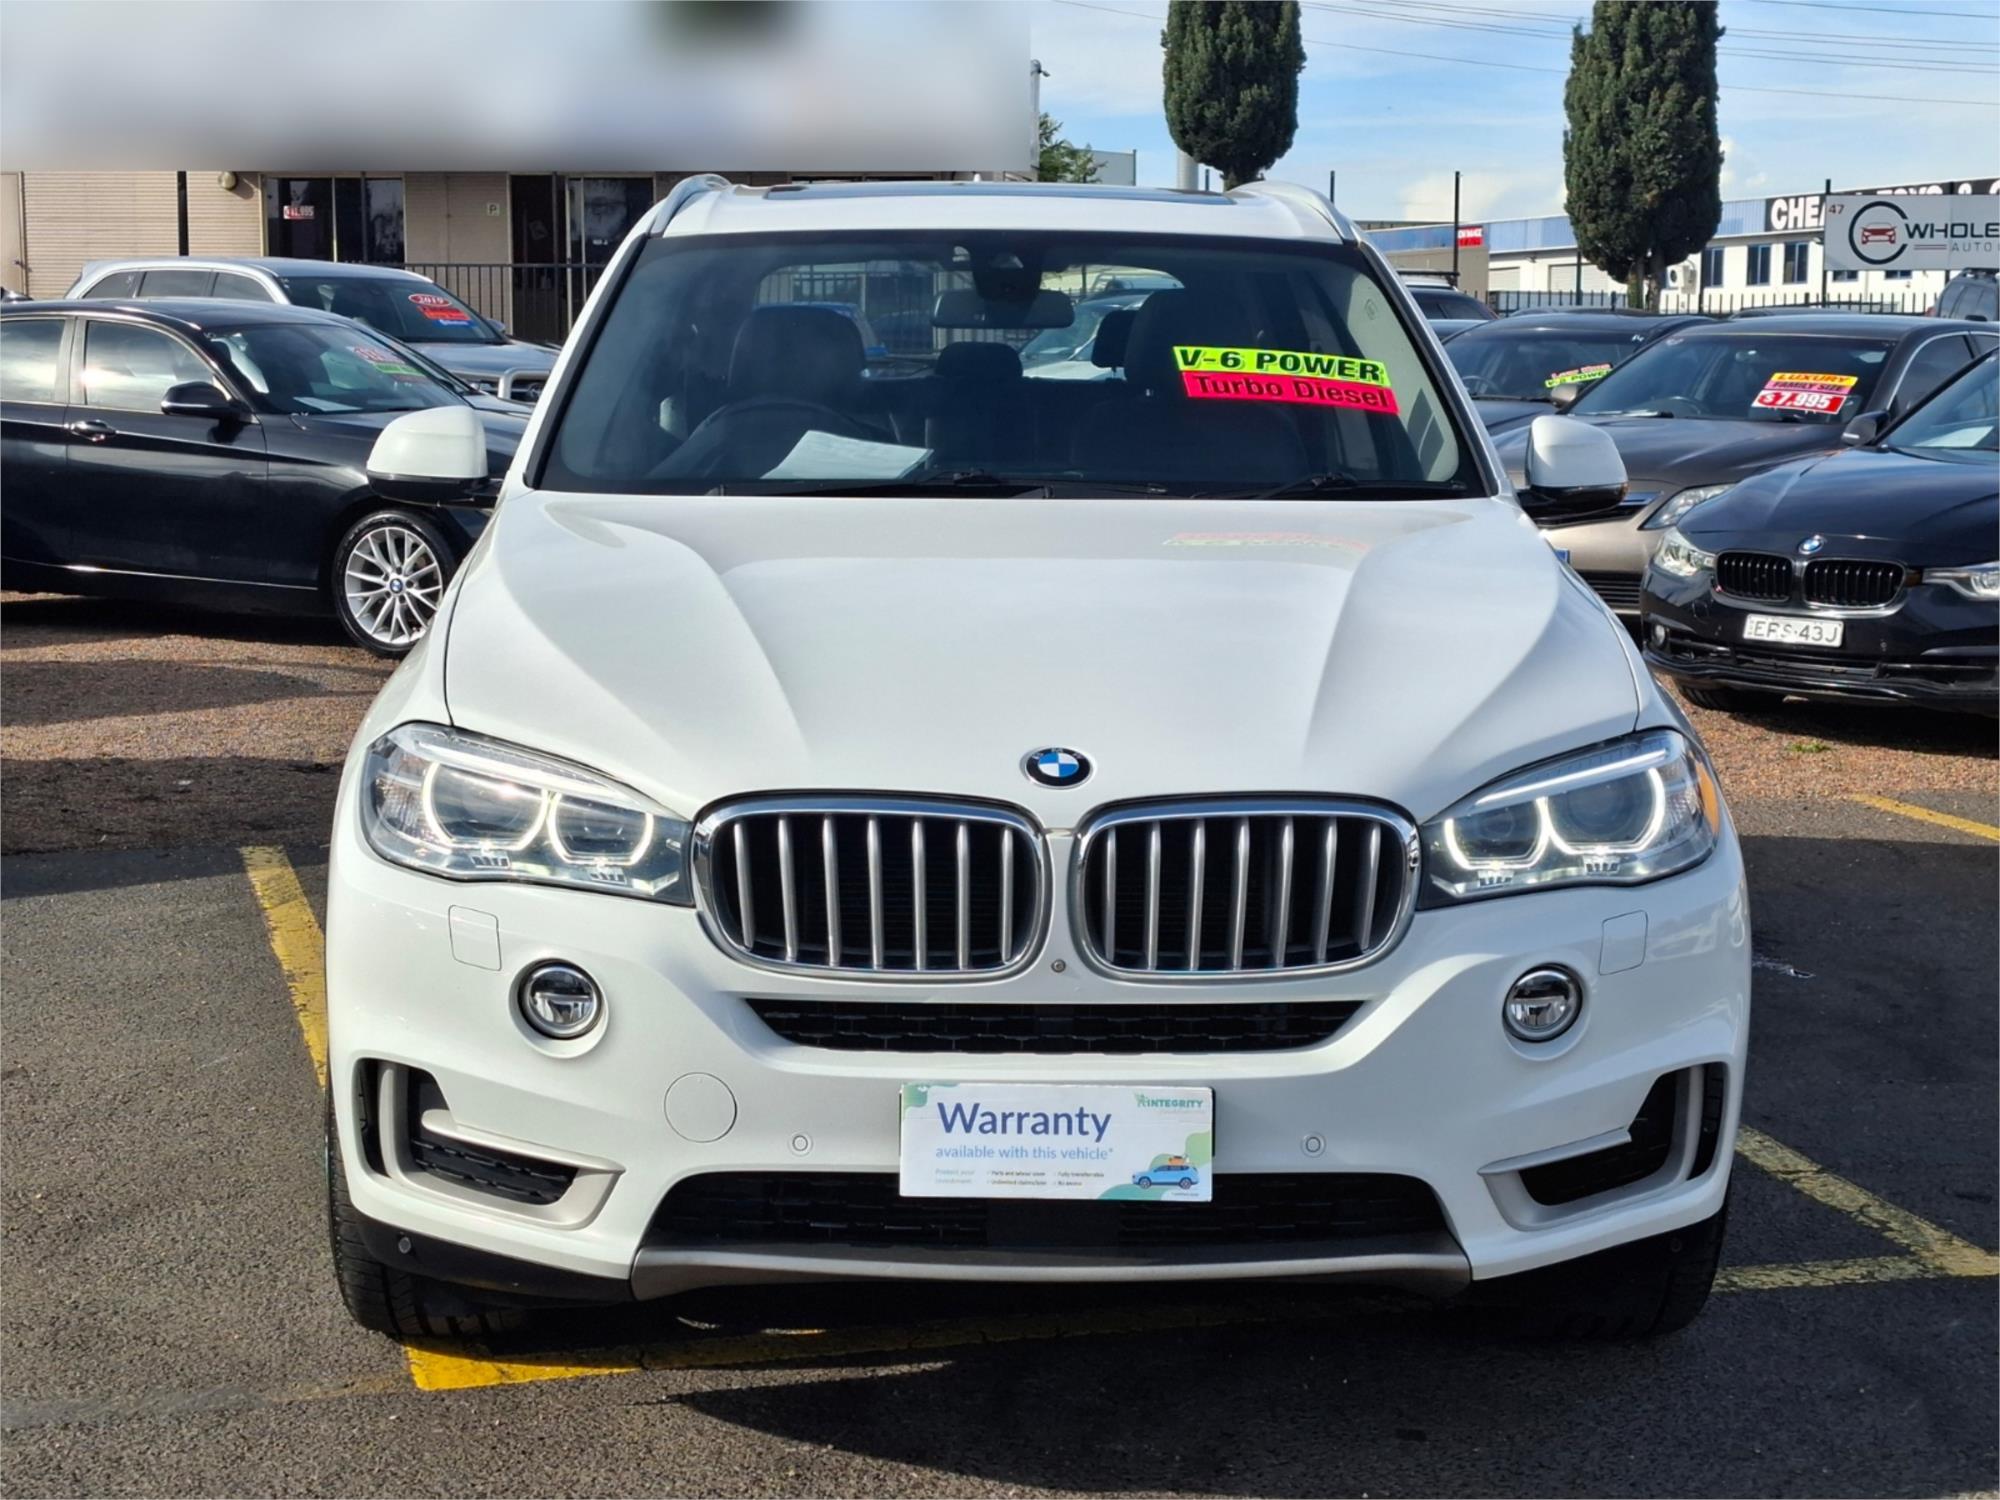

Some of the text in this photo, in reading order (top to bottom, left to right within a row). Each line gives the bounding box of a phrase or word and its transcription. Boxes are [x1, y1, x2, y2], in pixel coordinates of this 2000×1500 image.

[1771, 196, 1824, 230] CHE
[1828, 204, 1845, 215] 47
[1905, 223, 2000, 239] WHOLE
[1951, 242, 1993, 252] AUTO
[1180, 349, 1381, 382] V-6 POWER
[1193, 375, 1390, 408] Turbo Diesel
[1146, 1098, 1203, 1108] INTEGRITY
[937, 1102, 1112, 1143] Warranty
[935, 1145, 994, 1159] available
[1000, 1146, 1028, 1159] with
[1032, 1146, 1057, 1160] this
